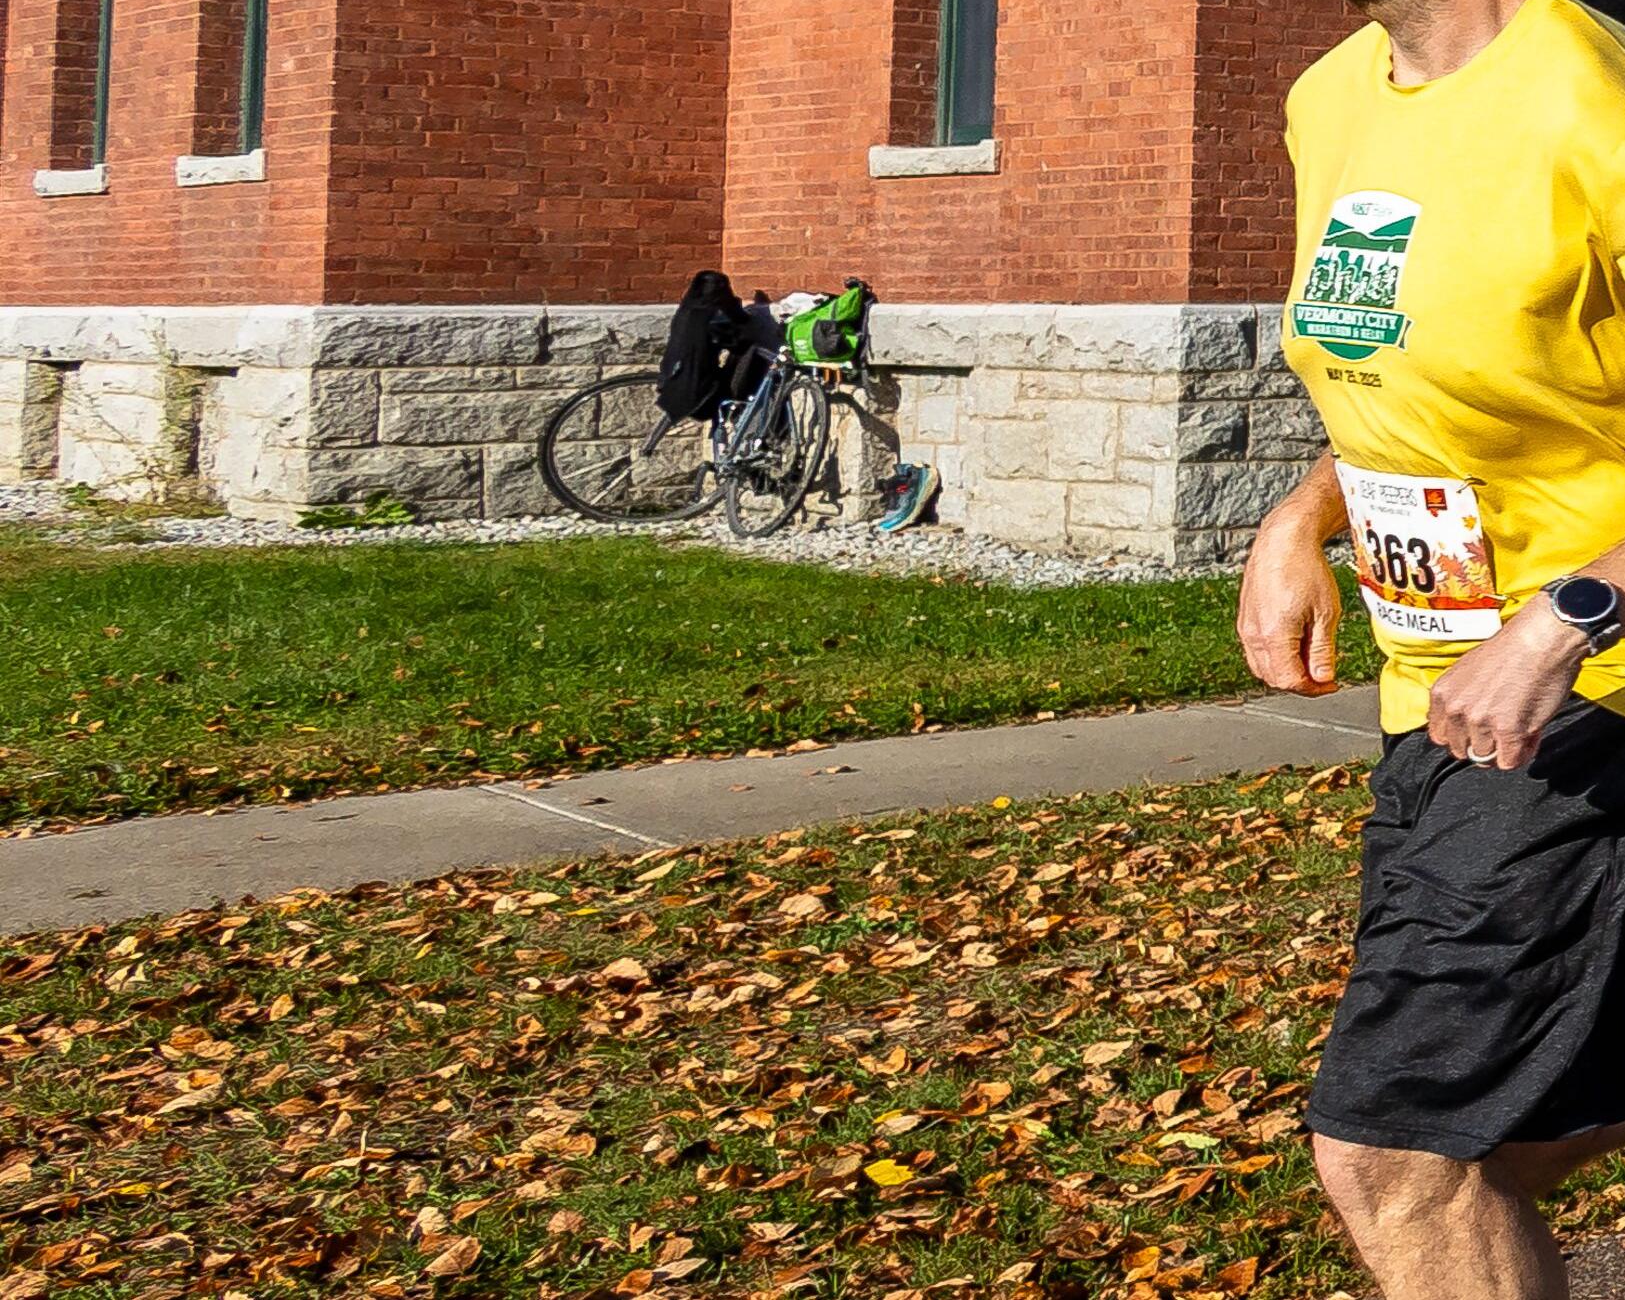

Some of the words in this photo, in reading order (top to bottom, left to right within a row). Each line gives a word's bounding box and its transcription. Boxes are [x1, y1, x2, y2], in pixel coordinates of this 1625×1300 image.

[1365, 312, 1399, 330] CITY
[1366, 528, 1436, 594] 363
[1405, 611, 1454, 634] MEAL
